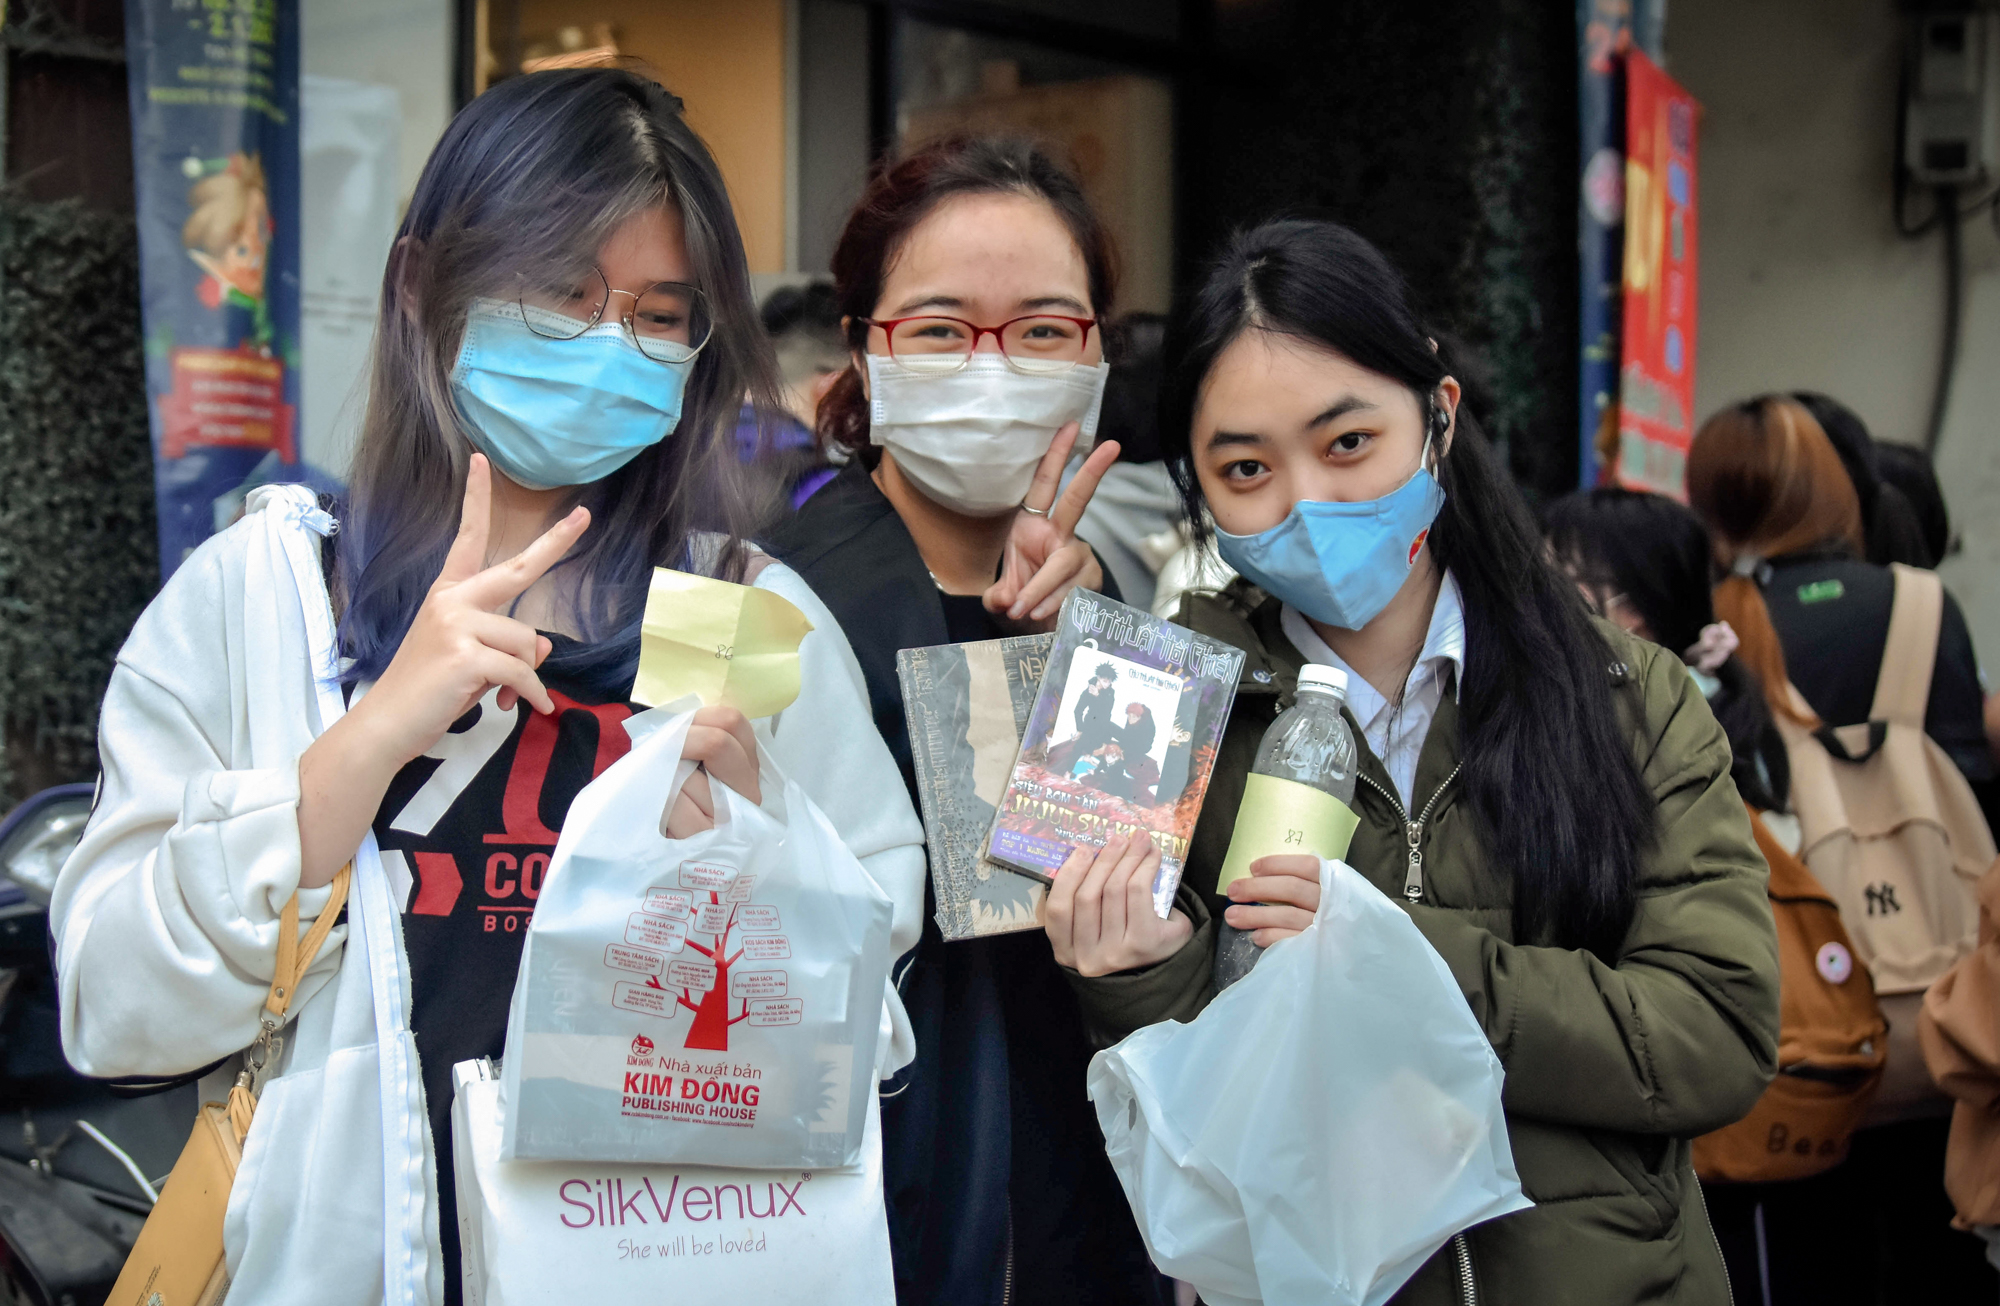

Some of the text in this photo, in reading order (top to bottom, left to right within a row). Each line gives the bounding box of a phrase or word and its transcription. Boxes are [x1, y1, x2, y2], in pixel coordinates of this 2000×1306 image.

[715, 644, 734, 660] 86
[1046, 787, 1072, 803] BOM
[1010, 794, 1108, 836] JUJUTSU
[1284, 828, 1303, 845] 87
[627, 1054, 638, 1066] KIM
[659, 1056, 762, 1079] Nhà xuất bản
[623, 1071, 760, 1107] KIM ĐỒNG
[622, 1096, 757, 1120] PUBLISHING HOUSE
[617, 1231, 767, 1260] She will be loved
